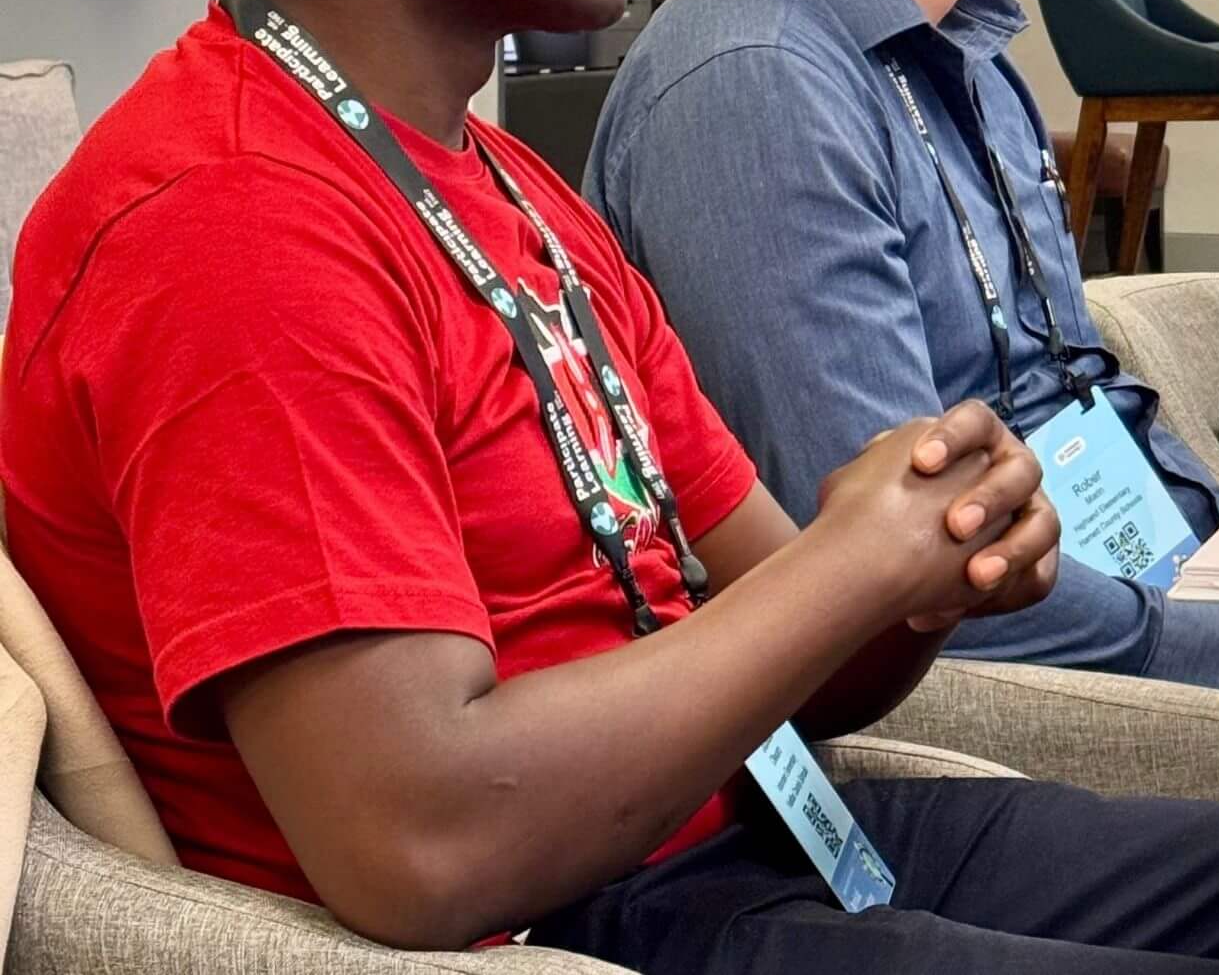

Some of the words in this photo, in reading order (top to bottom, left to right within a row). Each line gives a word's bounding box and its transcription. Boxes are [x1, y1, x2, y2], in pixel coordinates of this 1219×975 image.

[254, 28, 333, 101] Participate
[415, 200, 487, 286] Participate
[547, 402, 591, 502] Participate
